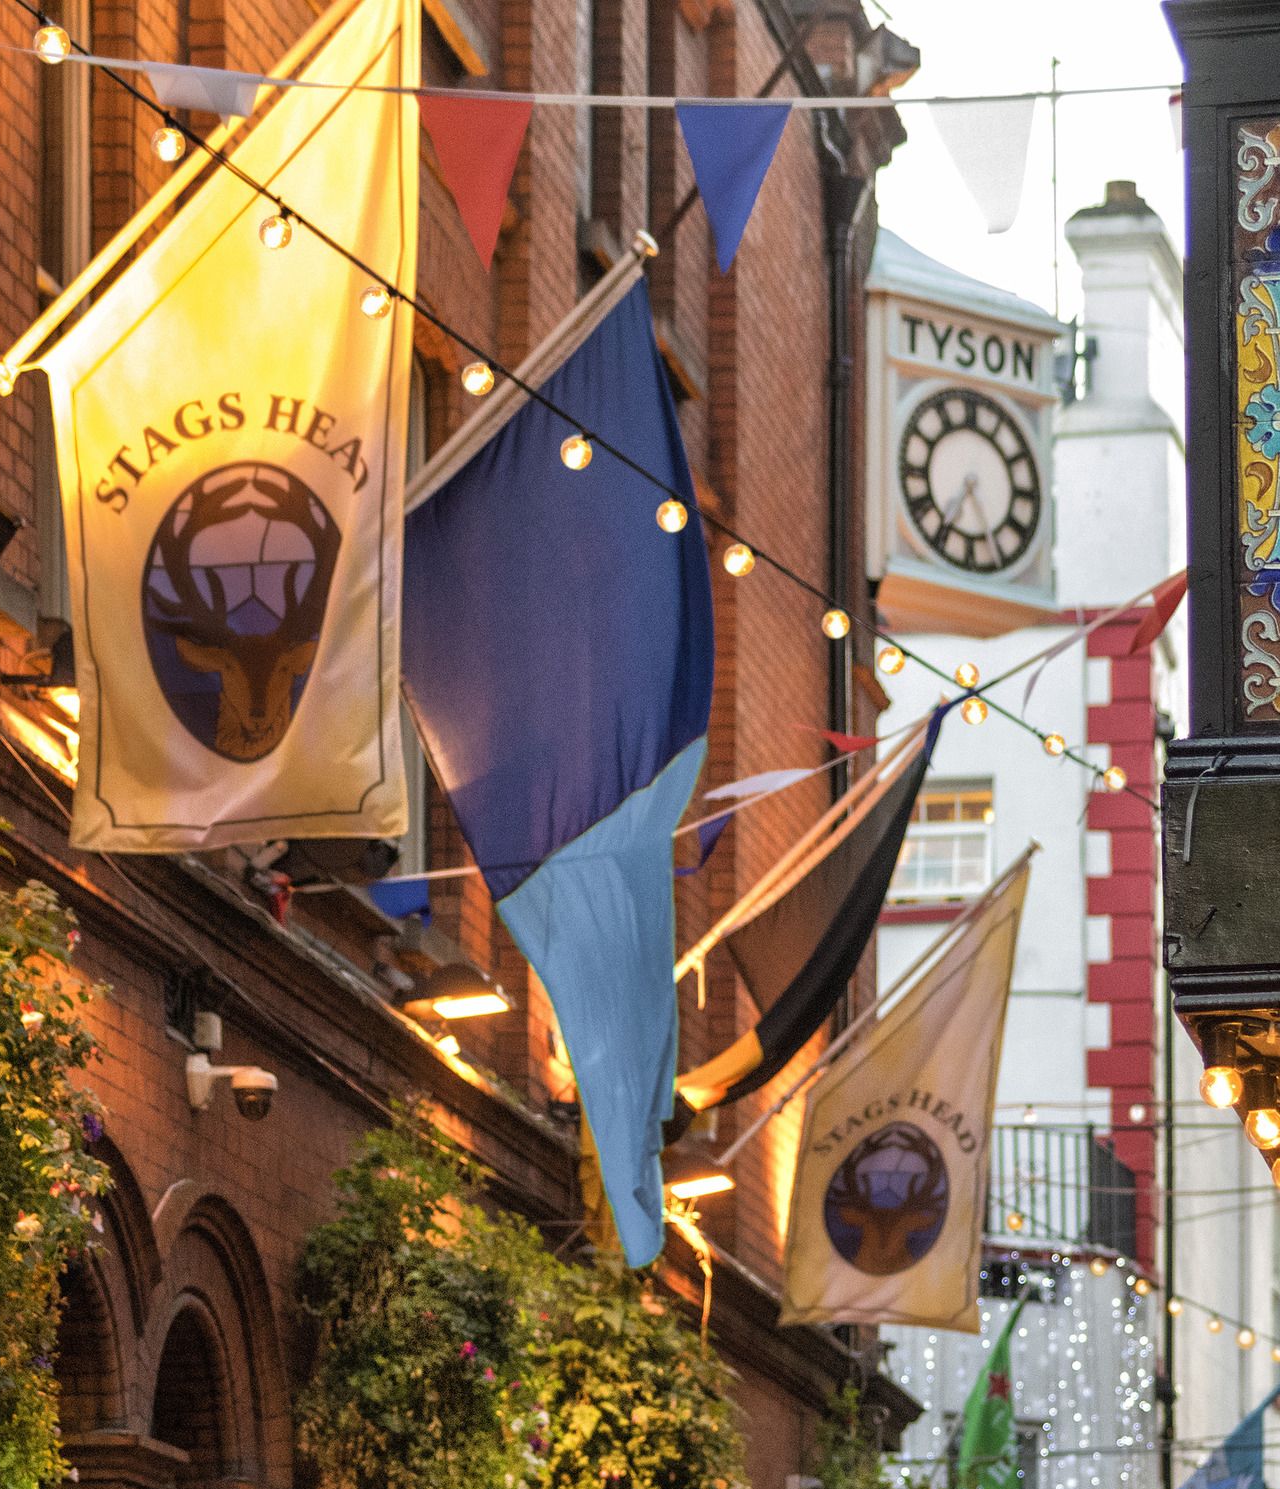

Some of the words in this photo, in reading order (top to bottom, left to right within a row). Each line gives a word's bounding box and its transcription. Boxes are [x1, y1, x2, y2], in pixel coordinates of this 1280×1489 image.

[901, 313, 1034, 382] TYSON
[95, 392, 245, 514] STAGS
[813, 1092, 900, 1154] STAGS
[908, 1089, 977, 1153] HEAD
